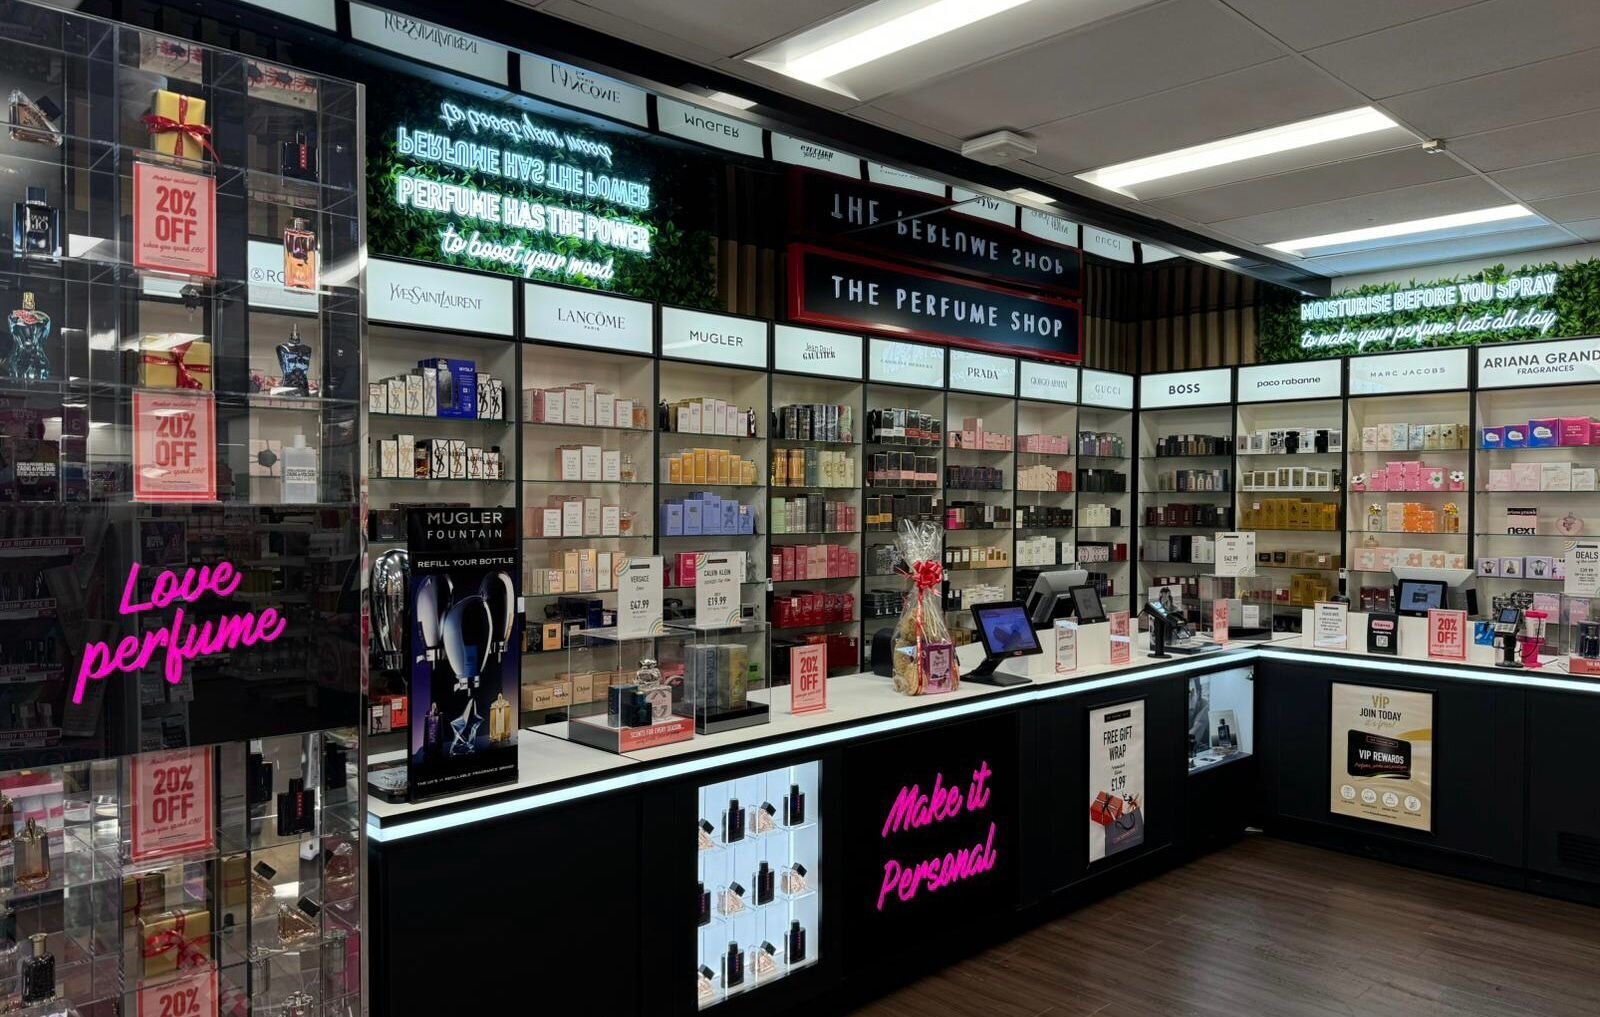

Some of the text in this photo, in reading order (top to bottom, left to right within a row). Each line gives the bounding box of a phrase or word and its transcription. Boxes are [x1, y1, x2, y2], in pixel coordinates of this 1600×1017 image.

[156, 185, 197, 217] 20%
[397, 175, 651, 252] PERFUME HAS THE POWER
[155, 215, 198, 245] OFF
[440, 223, 615, 281] to boost your mood
[1301, 273, 1557, 320] MOISTURISE BEFORE YOU SPRAY
[832, 276, 1063, 338] THE PERFUME SHOP
[557, 307, 626, 330] LANCÔME
[689, 330, 743, 347] MUGLER
[1301, 307, 1558, 354] to make your perfume last all day
[1484, 355, 1540, 369] ARIANA
[1517, 365, 1575, 375] FRAGRANCES
[967, 367, 999, 380] PRADA
[1370, 366, 1446, 378] MARC JACOBS
[1095, 384, 1121, 395] GUCCI
[1168, 383, 1201, 395] BOSS
[1257, 376, 1321, 388] paco rabanne
[156, 412, 197, 438] 20%
[155, 440, 198, 467] OFF
[427, 512, 503, 525] MUGLER
[427, 529, 502, 539] FOUNTAIN
[479, 557, 514, 565] BOTTLE
[1576, 551, 1598, 559] DEALS
[119, 562, 243, 614] Love
[1437, 617, 1457, 632] 20%
[1437, 632, 1457, 645] OFF
[73, 607, 287, 704] perfume
[801, 656, 818, 673] 20%
[801, 674, 818, 691] OFF
[1360, 708, 1402, 721] JOIN TODAY
[1104, 726, 1132, 746] FREE GIFT
[1109, 744, 1126, 761] WRAP
[1359, 749, 1404, 764] VIP REWARDS
[153, 765, 194, 795] 20%
[882, 760, 992, 838] Make it
[153, 793, 194, 823] OFF
[877, 822, 997, 912] Personal
[160, 987, 200, 1017] 20%
